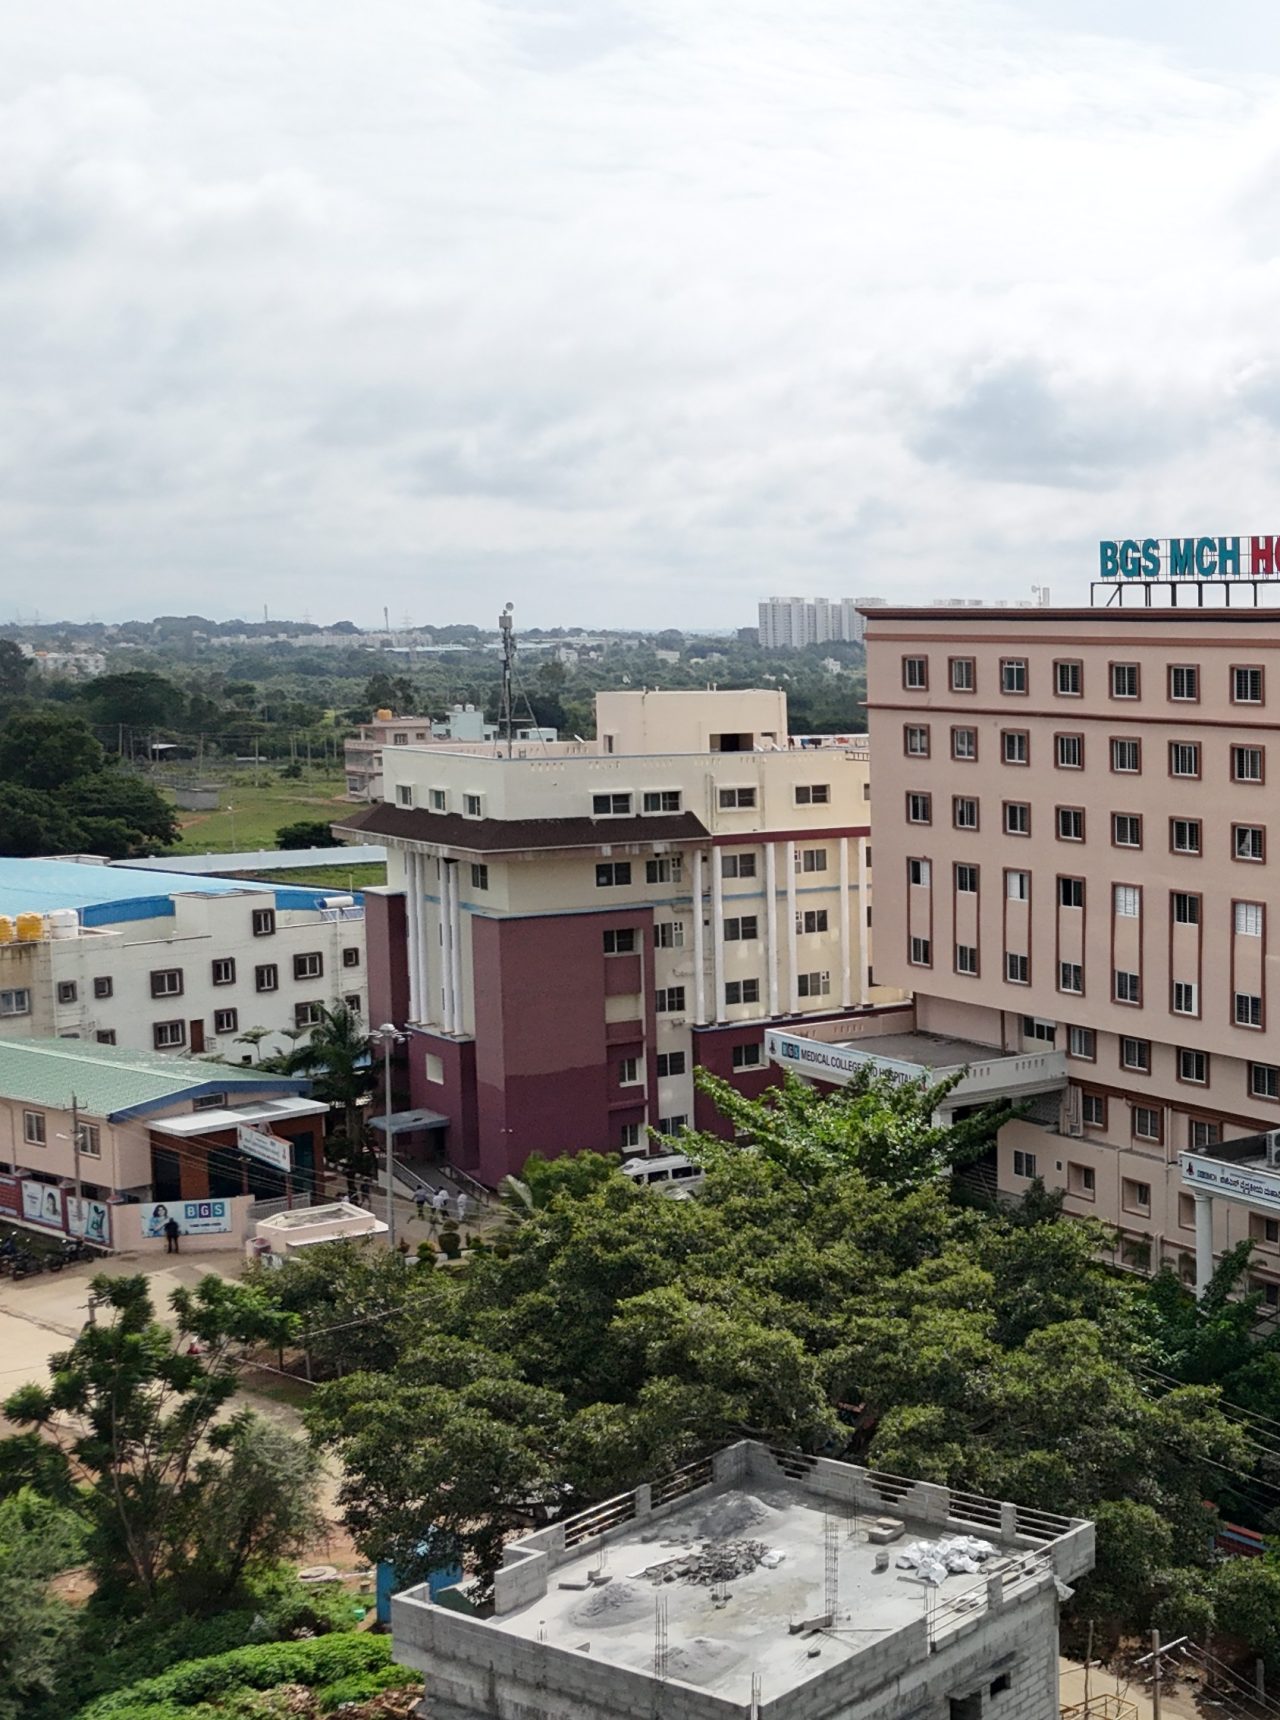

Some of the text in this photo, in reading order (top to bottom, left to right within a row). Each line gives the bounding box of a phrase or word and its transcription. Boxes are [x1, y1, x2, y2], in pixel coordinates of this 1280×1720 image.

[1100, 539, 1160, 577] BGS
[1170, 536, 1241, 577] MCH
[801, 1049, 830, 1067] MEDICAL
[186, 1203, 224, 1218] BGS
